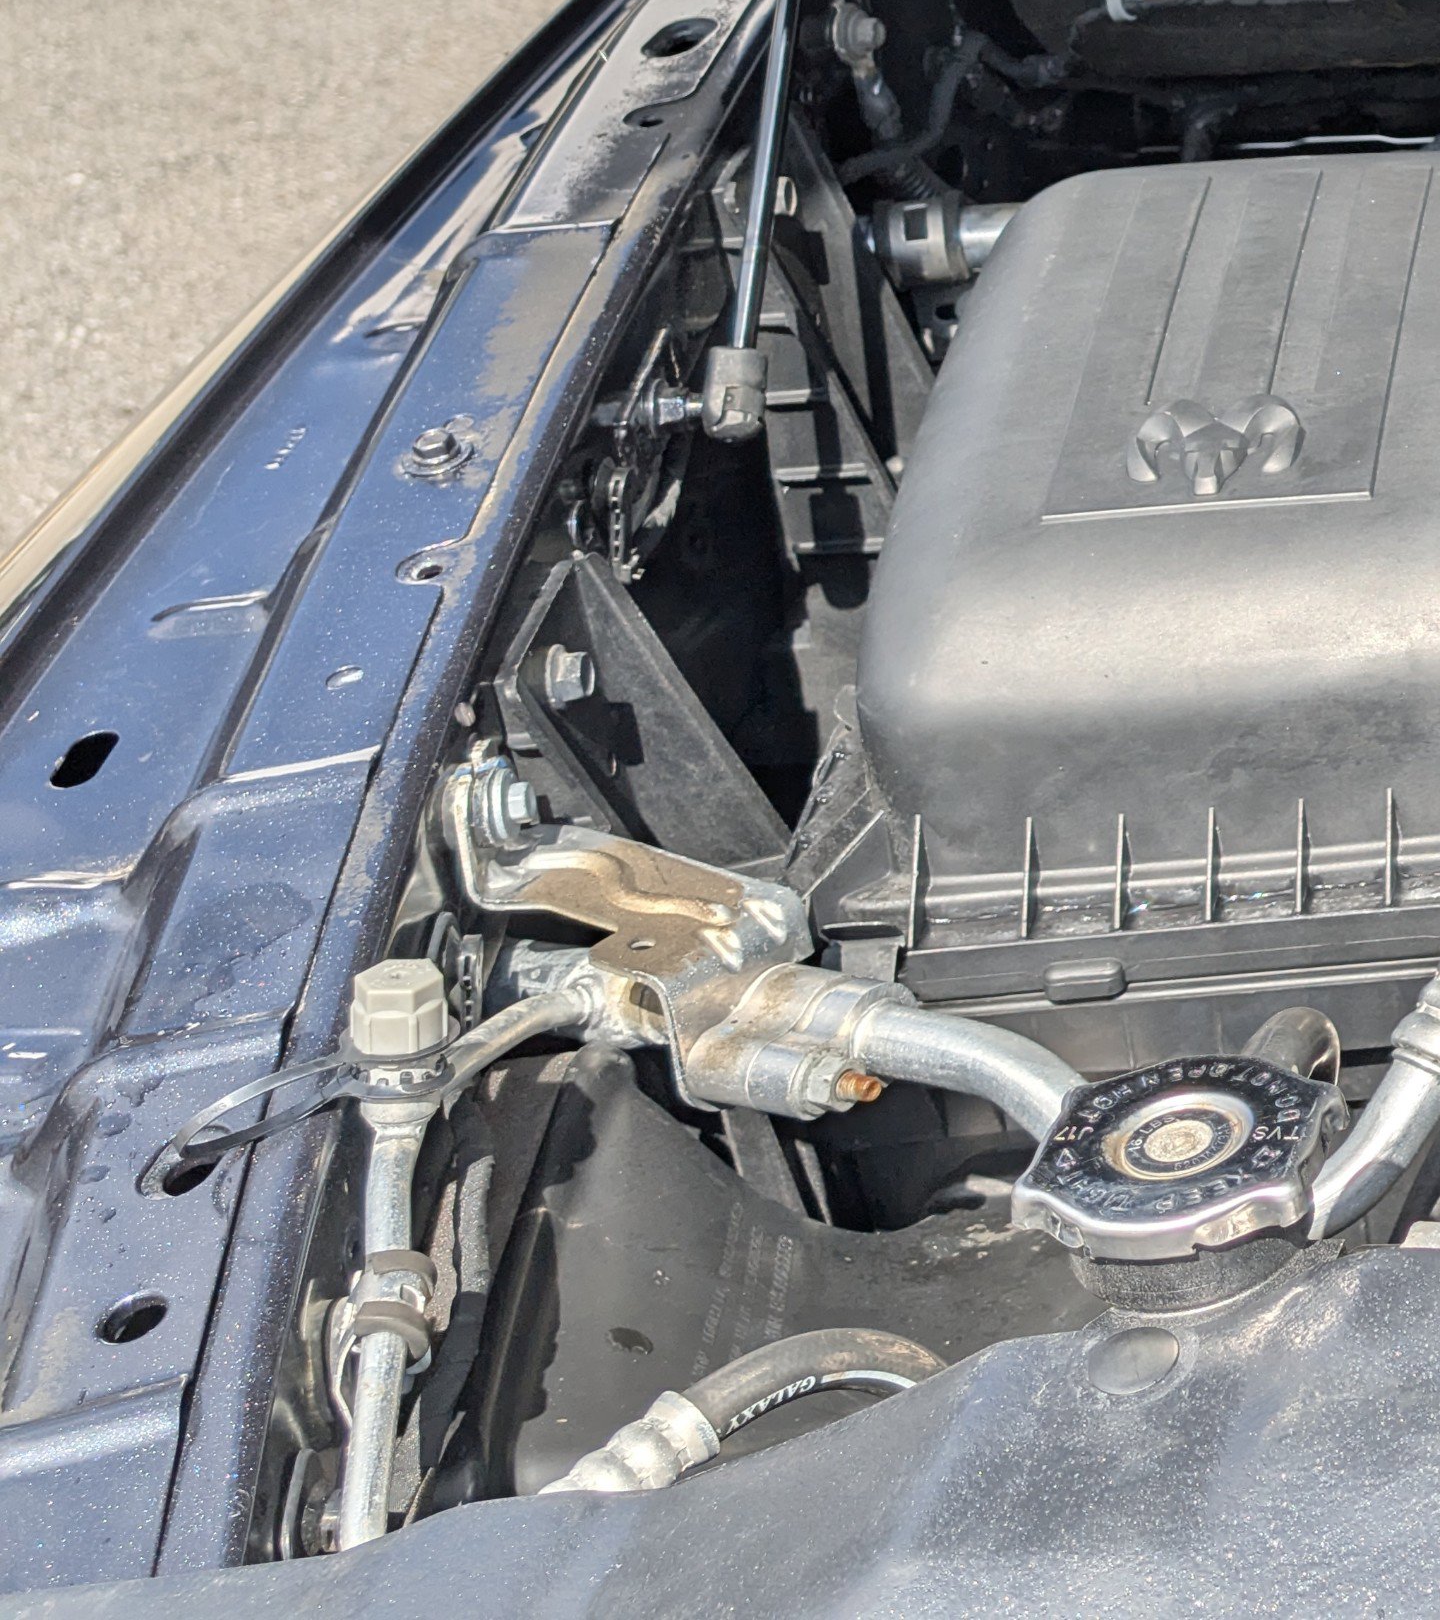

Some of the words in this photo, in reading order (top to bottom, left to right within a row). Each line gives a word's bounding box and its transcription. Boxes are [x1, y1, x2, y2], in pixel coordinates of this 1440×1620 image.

[1141, 1063, 1235, 1088] OPEN
[1252, 1125, 1301, 1140] TVS
[726, 1375, 817, 1435] GALAXY
